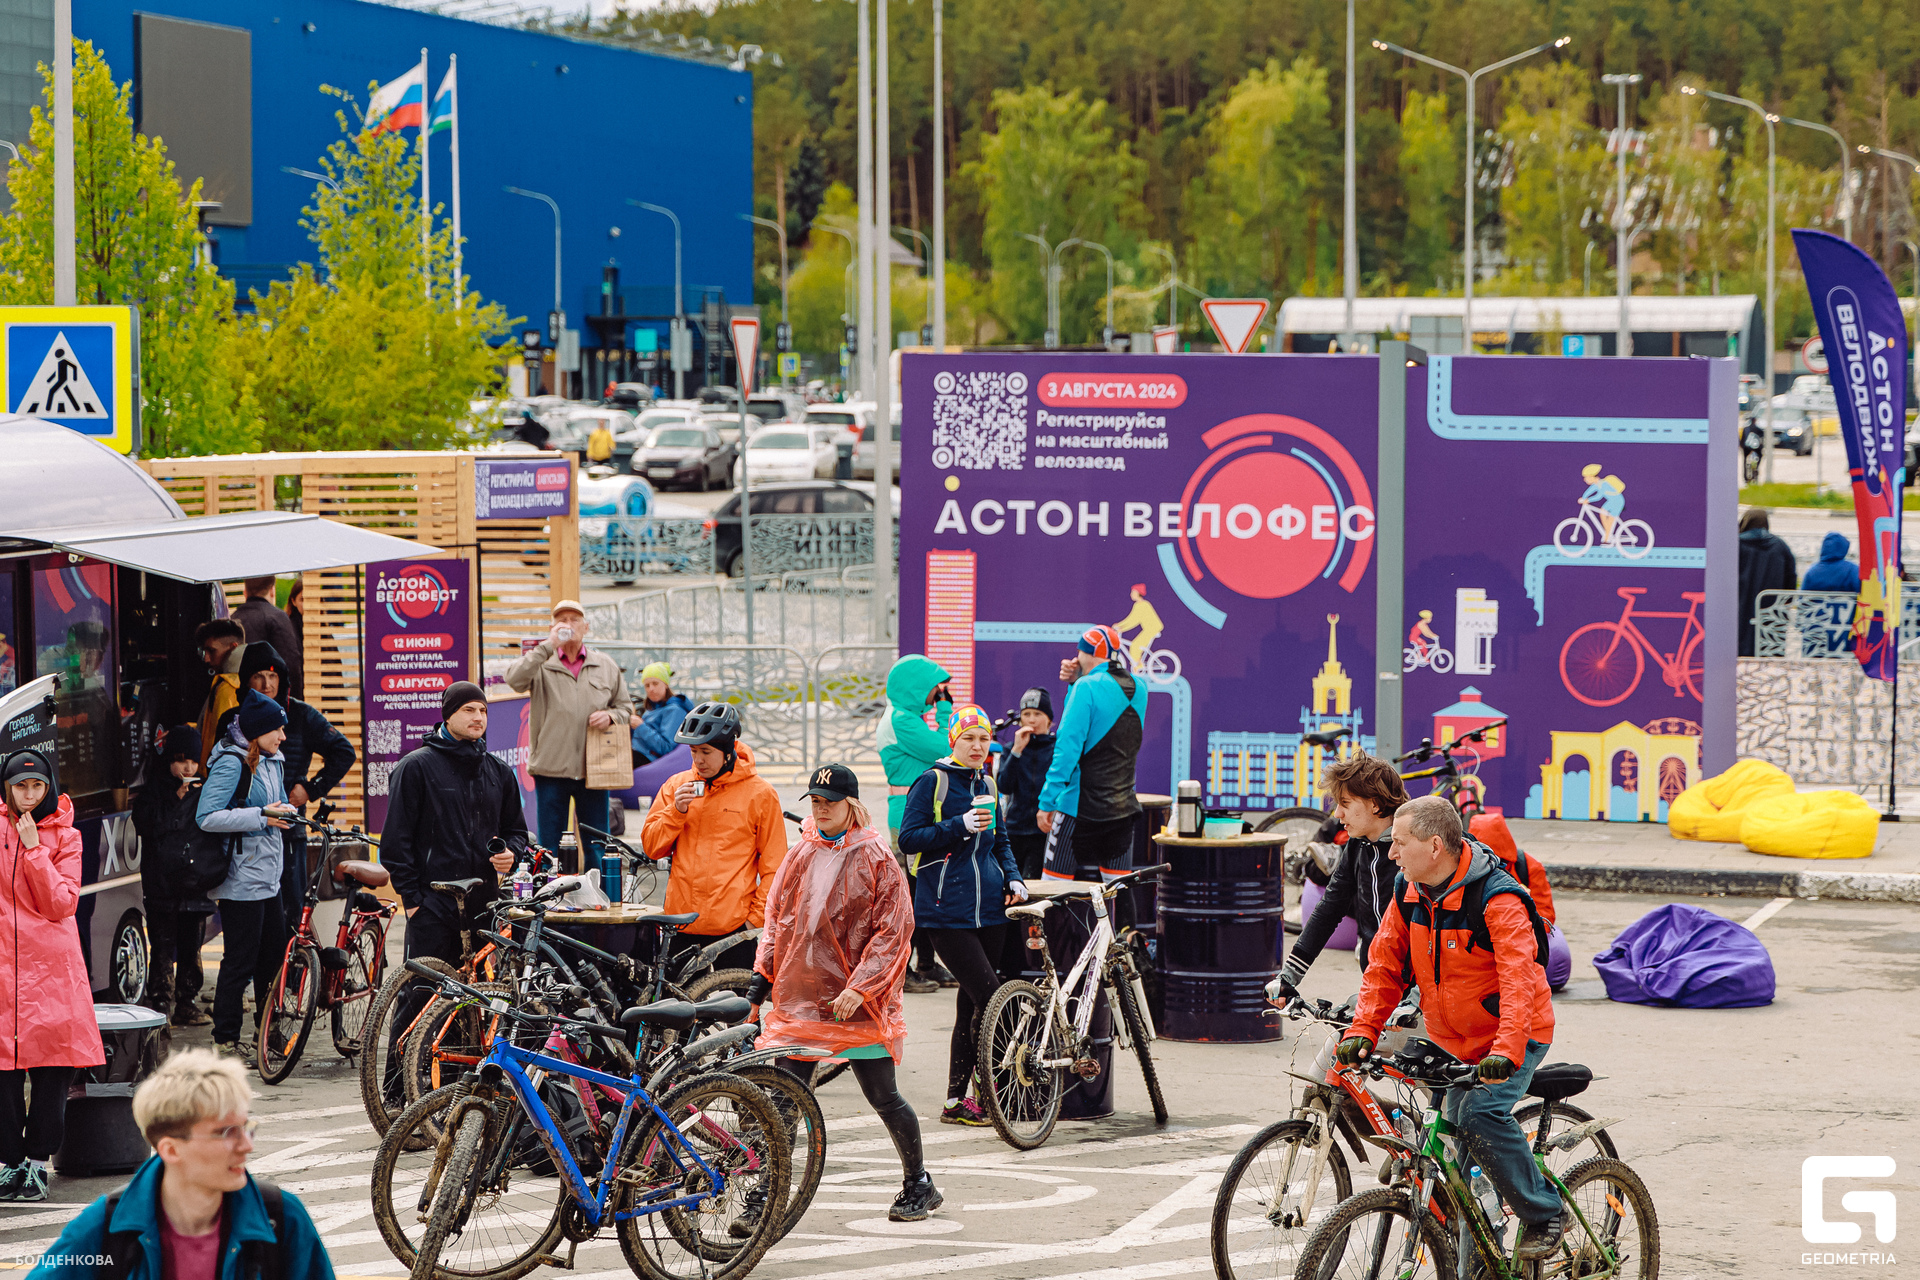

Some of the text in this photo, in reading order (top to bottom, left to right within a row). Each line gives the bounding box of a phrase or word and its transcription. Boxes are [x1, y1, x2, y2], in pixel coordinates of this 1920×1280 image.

[1047, 382, 1177, 398] 3 АВГУСТА 2024
[1836, 303, 1878, 477] ВЕЛОДВИЖ
[1868, 330, 1894, 452] АСТОН
[1036, 409, 1166, 432] Регистрируйся
[1035, 432, 1169, 449] на масштабный
[1034, 455, 1126, 471] велозаезд
[934, 499, 1375, 540] АСТОН ВЕЛОФЕС
[377, 577, 429, 590] АСТОН
[375, 589, 459, 602] ВЕЛОФЕСТ
[393, 637, 441, 648] 12 ИЮНЯ
[391, 654, 414, 662] СТАРТ
[419, 653, 443, 661] ЭТАПА
[375, 660, 459, 670] ЛЕТНЕГО КУБКА АСТОН
[388, 677, 445, 689] 3 АВГУСТА
[373, 692, 418, 703] ГОРОДСКОЙ
[411, 700, 443, 709] ВЕЛОФЕ
[816, 768, 832, 784] NY
